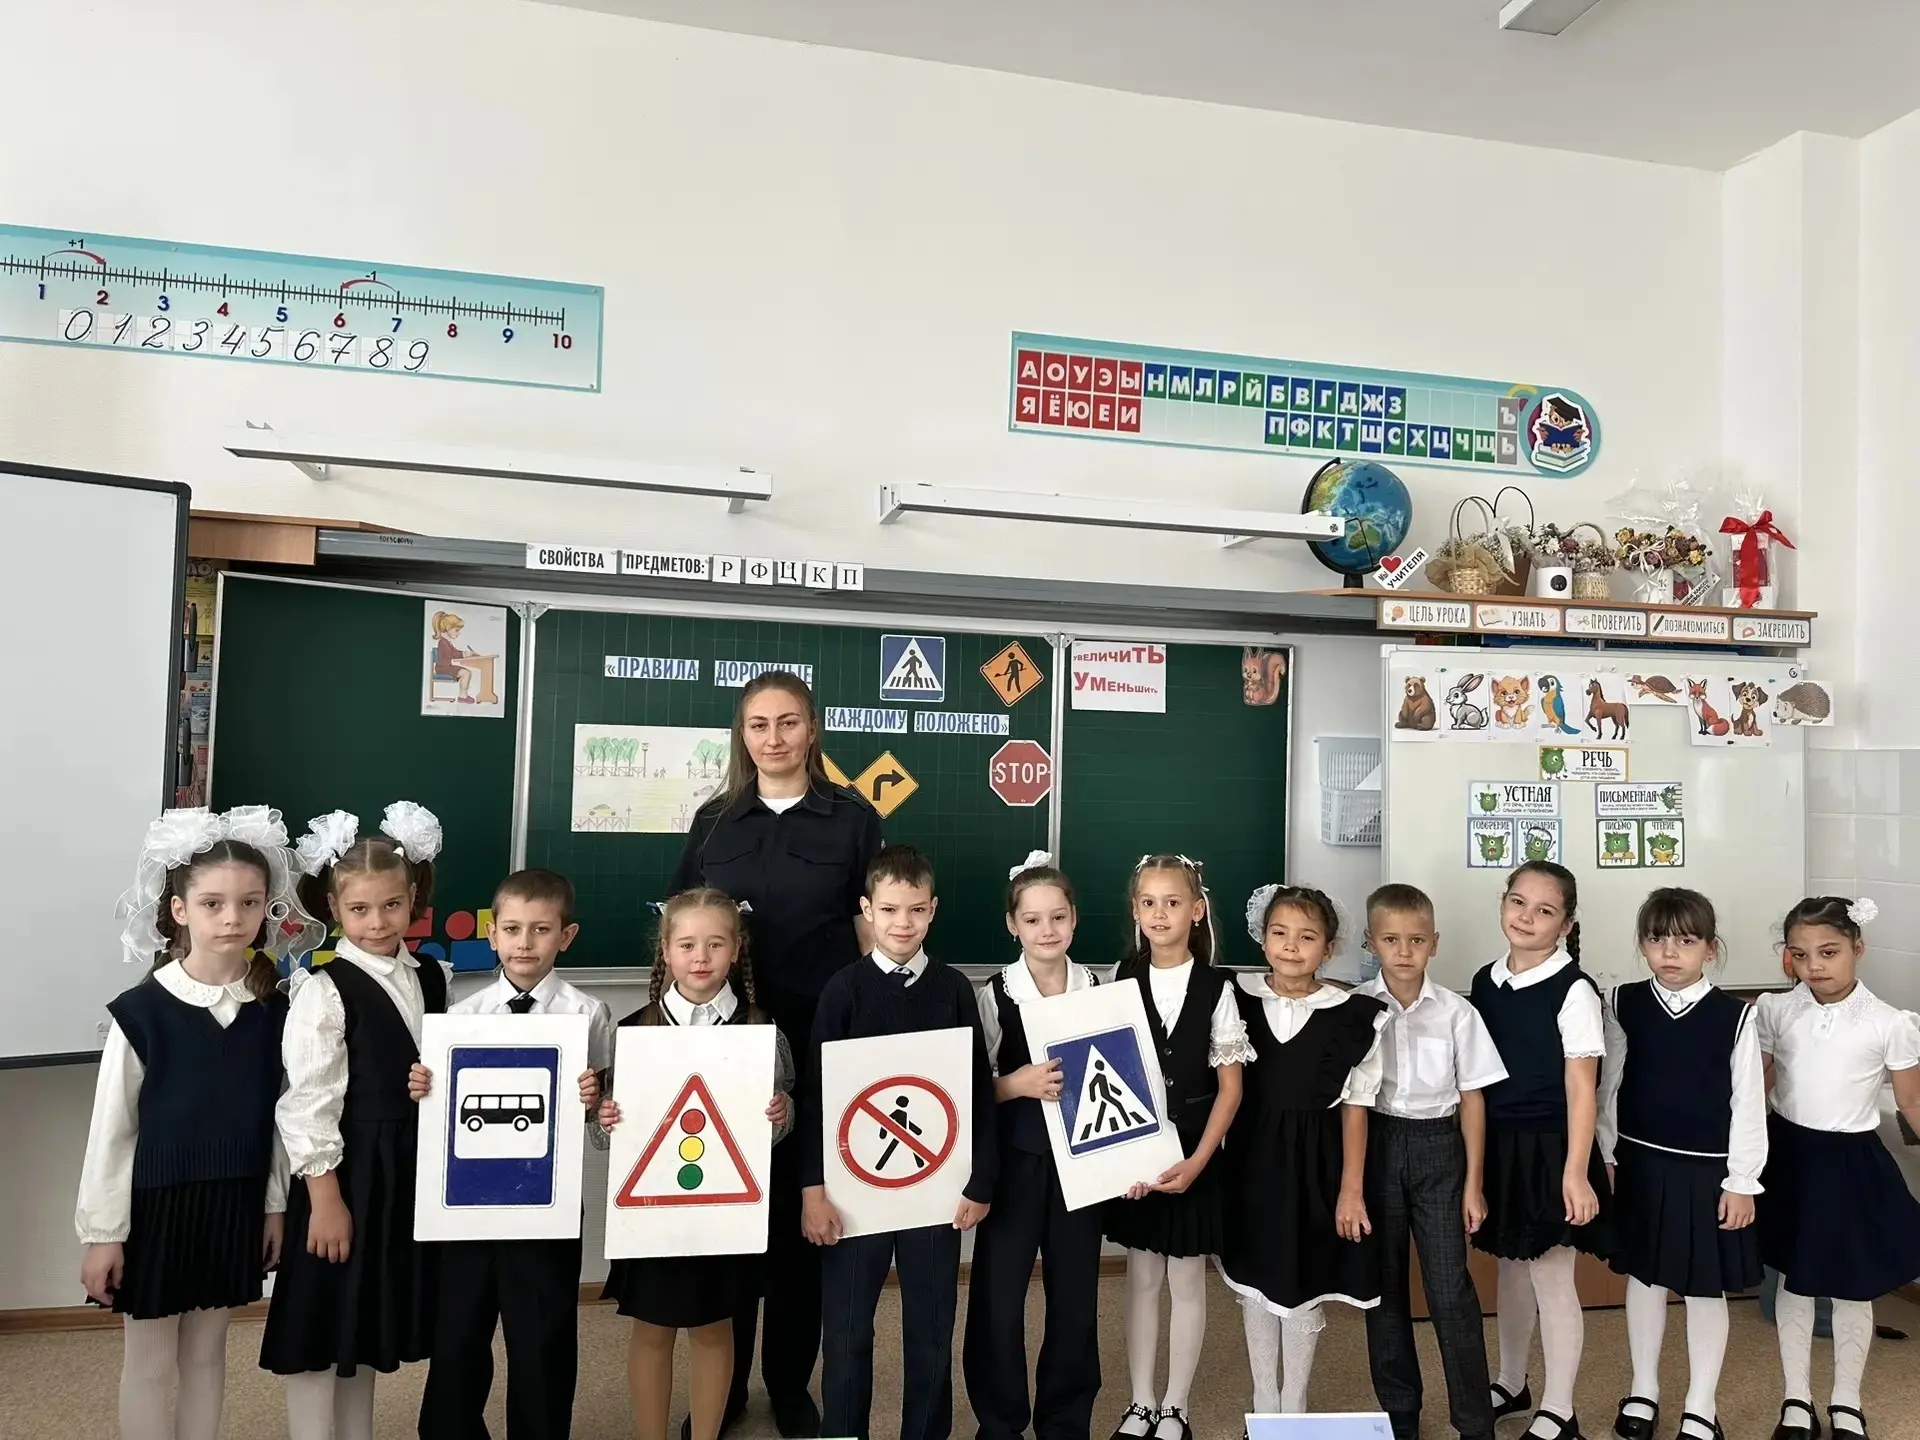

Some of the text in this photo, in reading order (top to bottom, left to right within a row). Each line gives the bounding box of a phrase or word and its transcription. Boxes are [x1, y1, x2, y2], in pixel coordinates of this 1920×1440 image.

[69, 238, 84, 249] +1
[365, 271, 377, 281] -1
[38, 284, 572, 349] 1 2 3 4 5 6 7 8 9 10
[64, 309, 430, 371] 0 1 2 3 4 5 6 7 8 9
[1021, 360, 1516, 425] А О У Э Ы Н М Л Р Й Б В Г Д Ж З Ъ
[1021, 394, 1515, 456] Я Ё Ю Е И П Ф К Т Ш С Х Ц Ч Щ Ь
[539, 547, 857, 585] СВОЙСТВА ПРЕДМЕТОВ: Р Ф Ц К П
[1387, 551, 1425, 588] УЧИТЕЛЯ
[1409, 605, 1466, 624] ЦЕЛЬ УРОКА
[1511, 611, 1546, 628] УЗНАТЬ
[1591, 614, 1642, 632] ПРОВЕРИТЬ
[1664, 619, 1725, 634] ПОЗНАКОМИТЬСЯ
[1757, 622, 1805, 640] ЗАКРЕПИТЬ
[606, 657, 698, 680] «ПРАВИЛА
[827, 708, 1008, 734] КАЖДОМУ ПОЛОЖЕНО»
[1581, 750, 1613, 767] РЕЧЬ
[994, 762, 1049, 784] STOP
[1504, 785, 1552, 803] УСТНАЯ
[1600, 790, 1657, 803] ПИСЬМЕННАЯ
